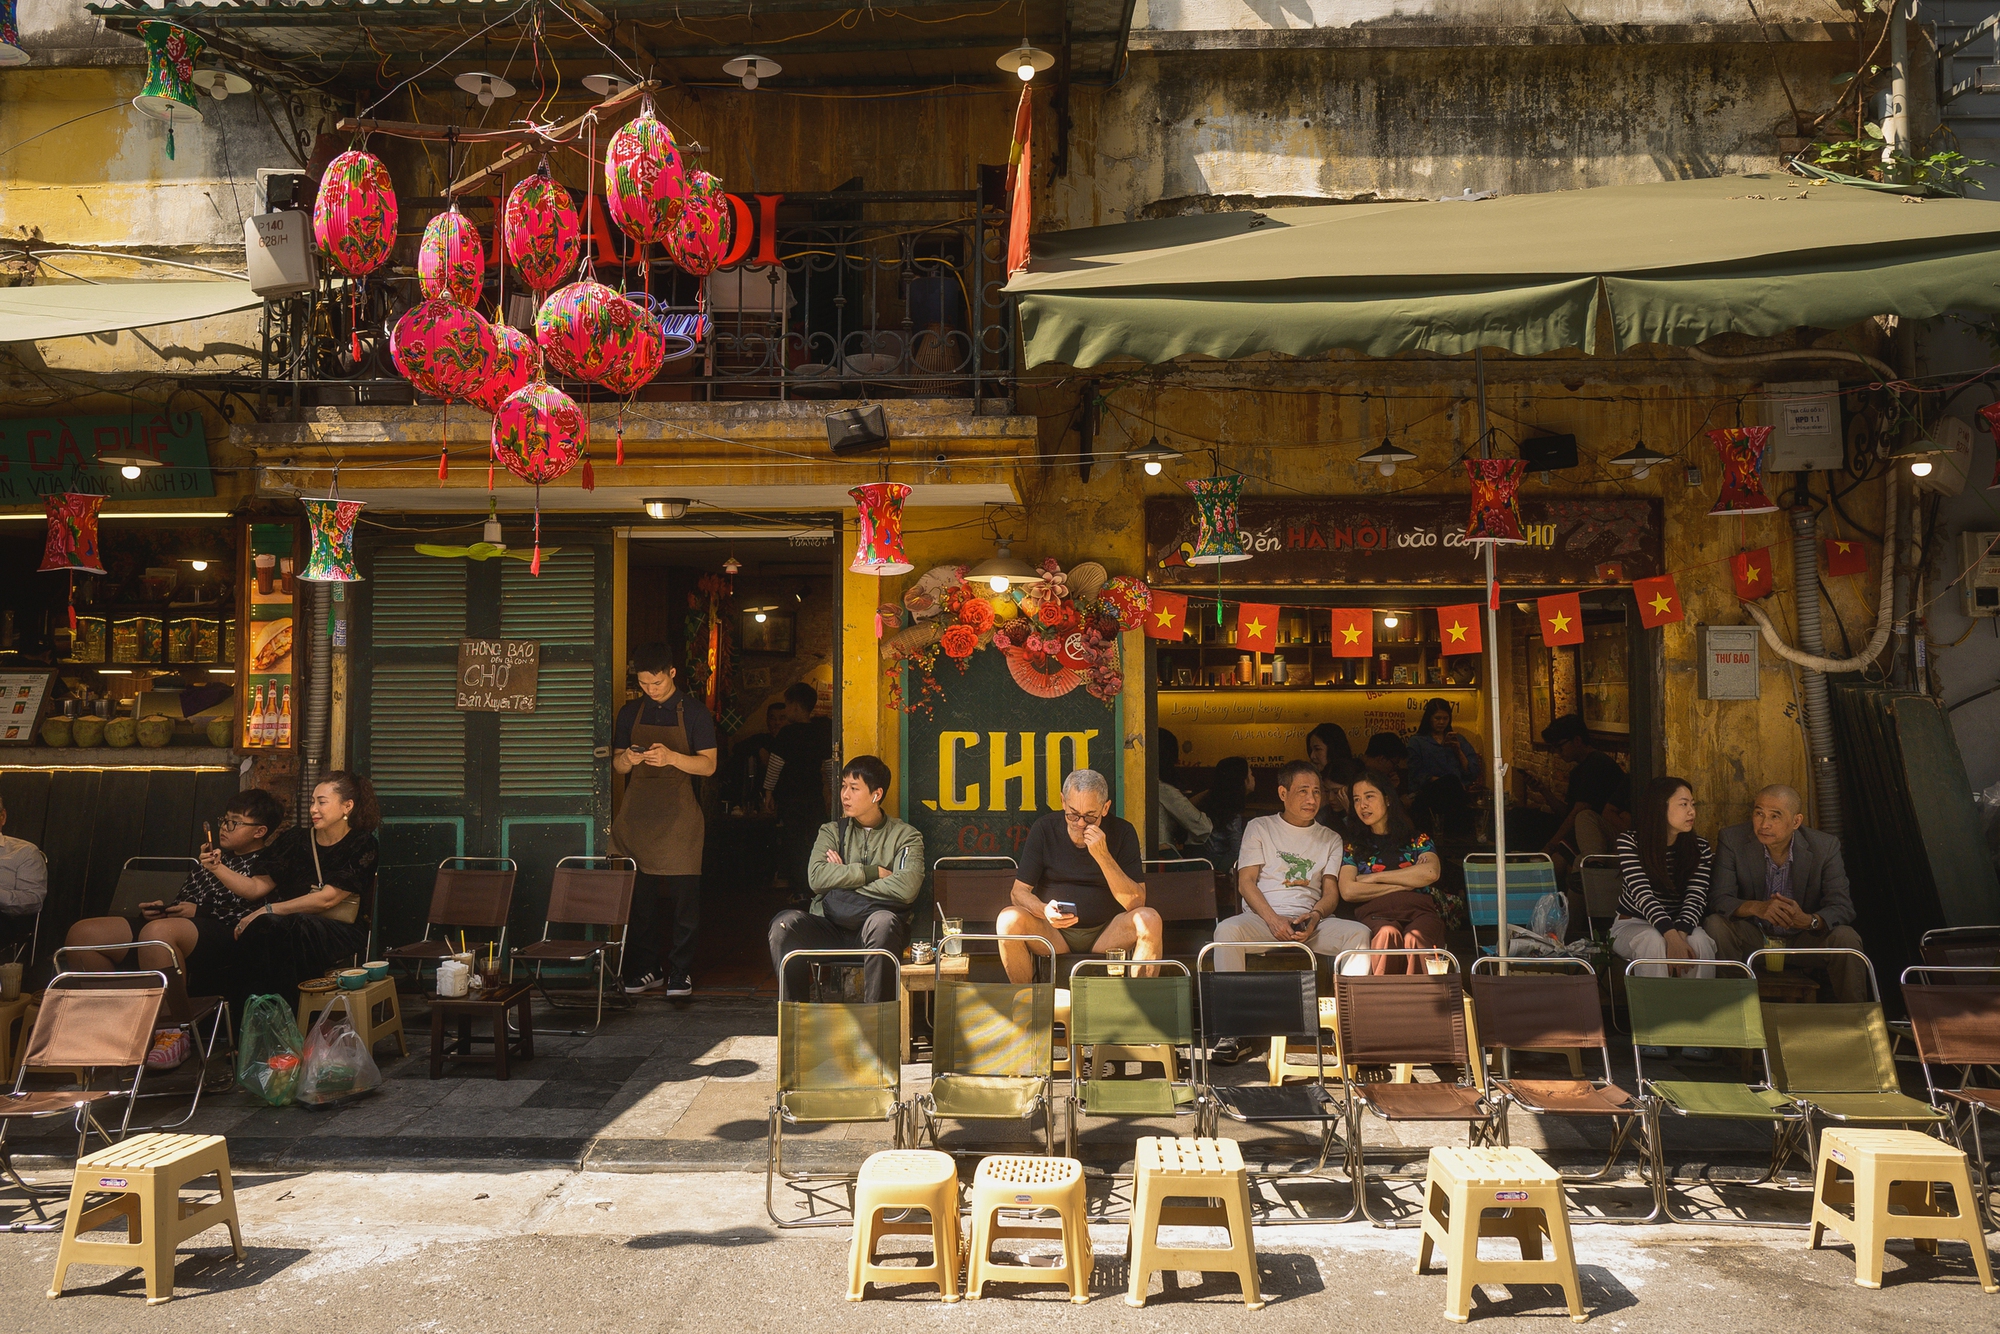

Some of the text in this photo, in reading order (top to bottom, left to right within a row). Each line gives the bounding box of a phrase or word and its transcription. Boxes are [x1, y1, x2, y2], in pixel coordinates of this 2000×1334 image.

[259, 219, 284, 232] P140
[259, 233, 289, 248] 628/H
[26, 418, 88, 471] CÀ
[26, 471, 67, 496] VỪA
[180, 472, 199, 491] ĐI
[1287, 520, 1327, 549] HÀ
[1334, 518, 1388, 557] NỘI
[1397, 526, 1438, 548] vào
[463, 641, 534, 657] THÔNG BÁO
[1715, 652, 1732, 664] THƯ
[464, 663, 512, 691] CHỢ
[457, 691, 482, 707] Bán
[957, 822, 1001, 854] Cà
